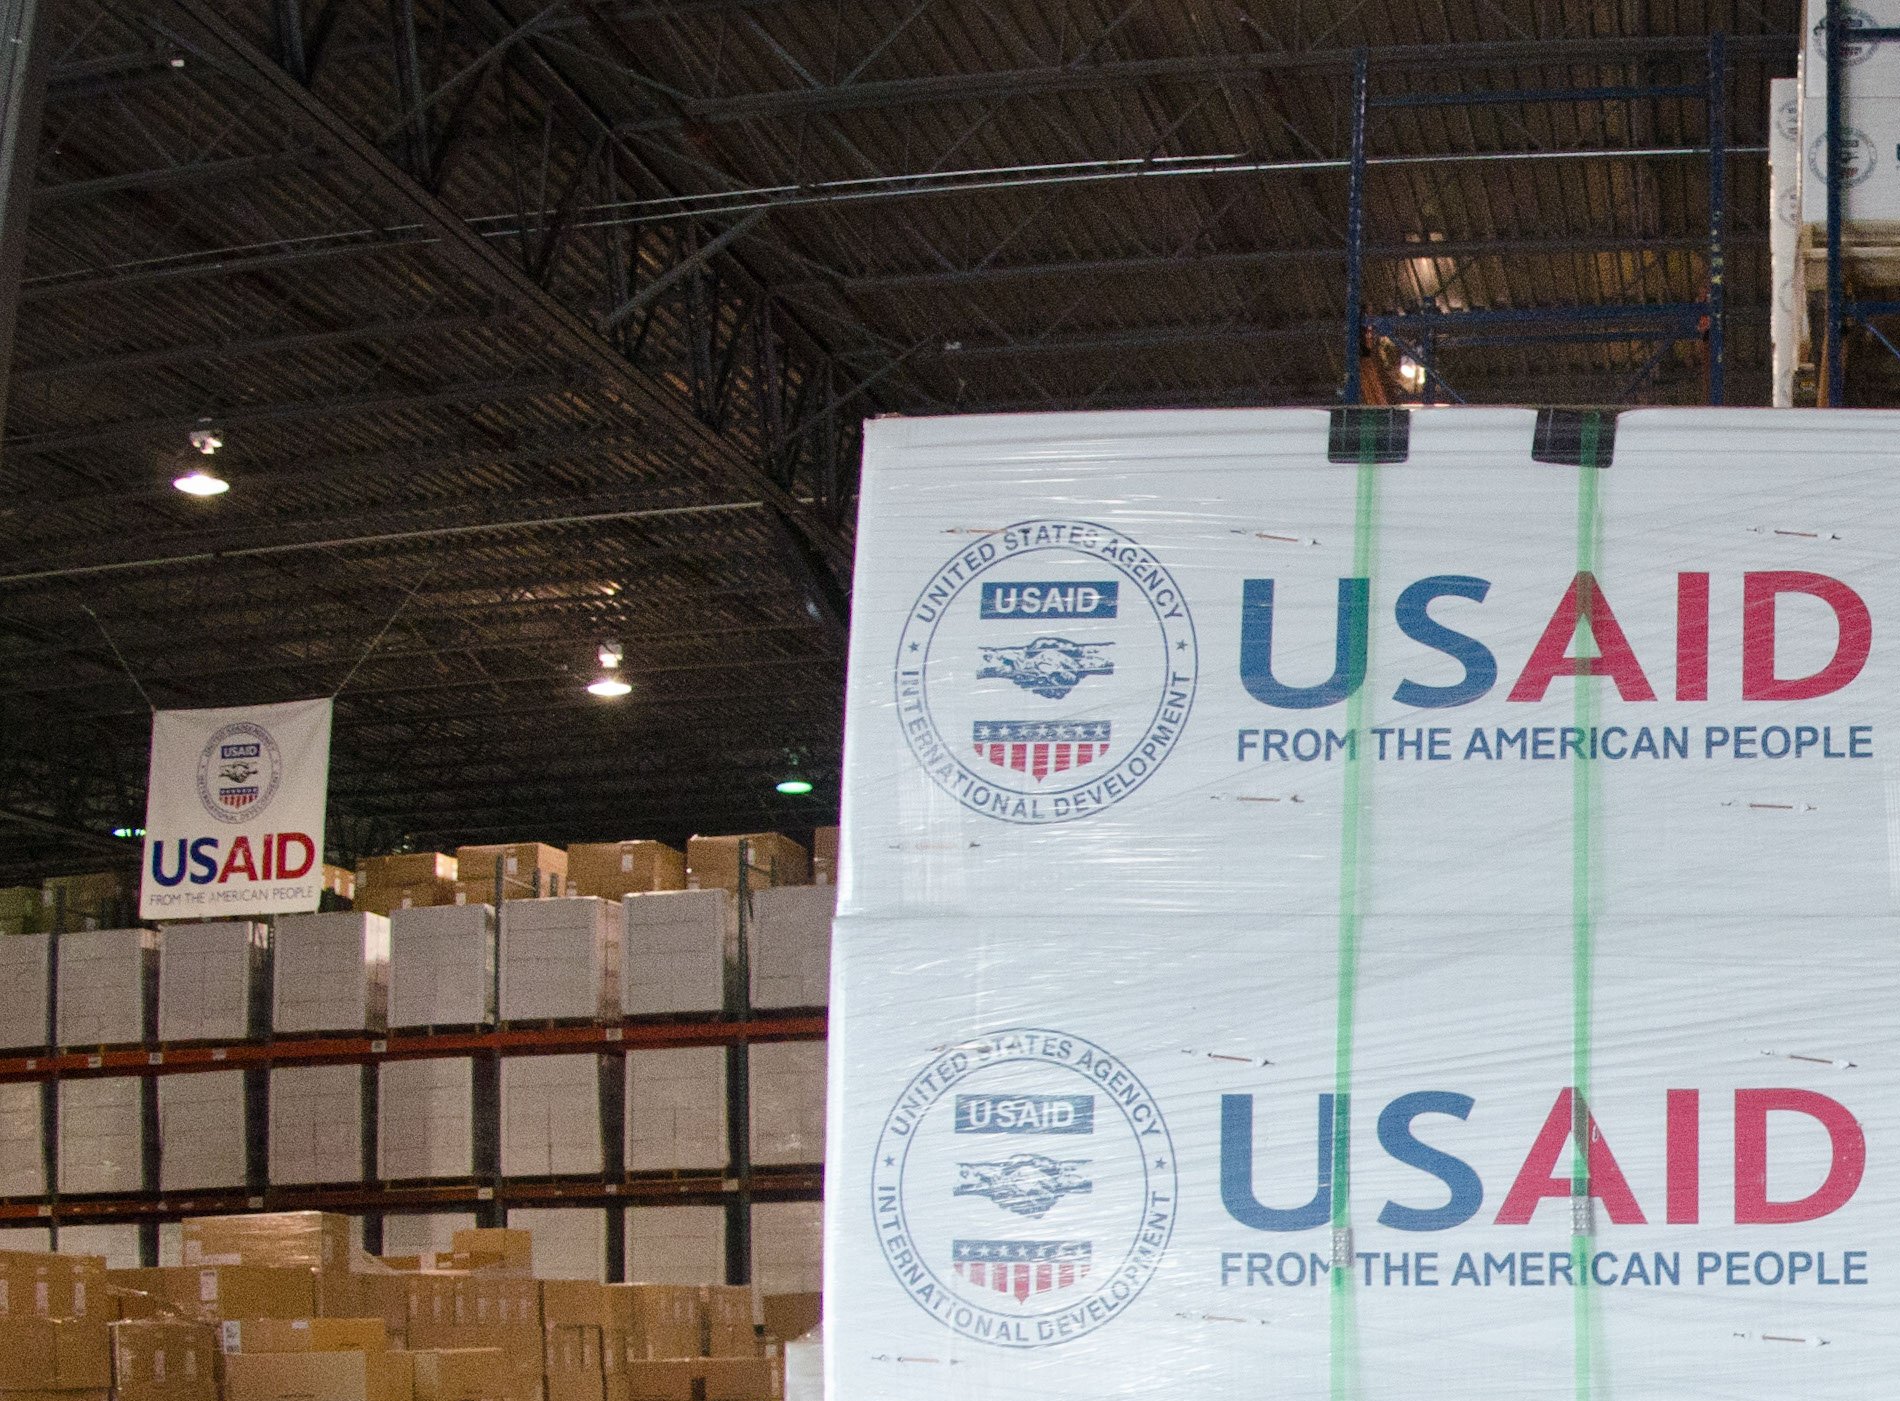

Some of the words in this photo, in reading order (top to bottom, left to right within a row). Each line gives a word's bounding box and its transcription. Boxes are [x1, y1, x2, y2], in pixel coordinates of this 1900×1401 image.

[915, 541, 997, 625] UNITED
[1002, 524, 1099, 553] STATES
[1100, 538, 1184, 621] AGENCY
[994, 586, 1100, 615] USAID
[1239, 570, 1872, 708] USAID
[899, 668, 1046, 821] INTERNATIONAL
[1053, 671, 1192, 821] DEVELOPMENT
[1237, 727, 1357, 763] FROM
[1370, 727, 1451, 761] THE
[1463, 726, 1689, 761] AMERICAN
[1705, 725, 1873, 760] PEOPLE
[149, 891, 181, 906] FROM
[184, 892, 206, 904] THE
[272, 885, 314, 900] PEOPLE
[152, 832, 316, 888] USAID
[890, 1050, 970, 1138] UNITED
[975, 1034, 1073, 1064] STATES
[1077, 1050, 1163, 1138] AGENCY
[967, 1099, 1076, 1129] USAID
[1221, 1087, 1866, 1232] USAID
[878, 1185, 1031, 1344] INTERNATIONAL
[1036, 1189, 1173, 1344] DEVELOPMENT
[1221, 1252, 1337, 1288] FROM
[1357, 1252, 1440, 1286] THE
[1451, 1251, 1679, 1287] AMERICAN
[1697, 1251, 1868, 1286] PEOPLE
